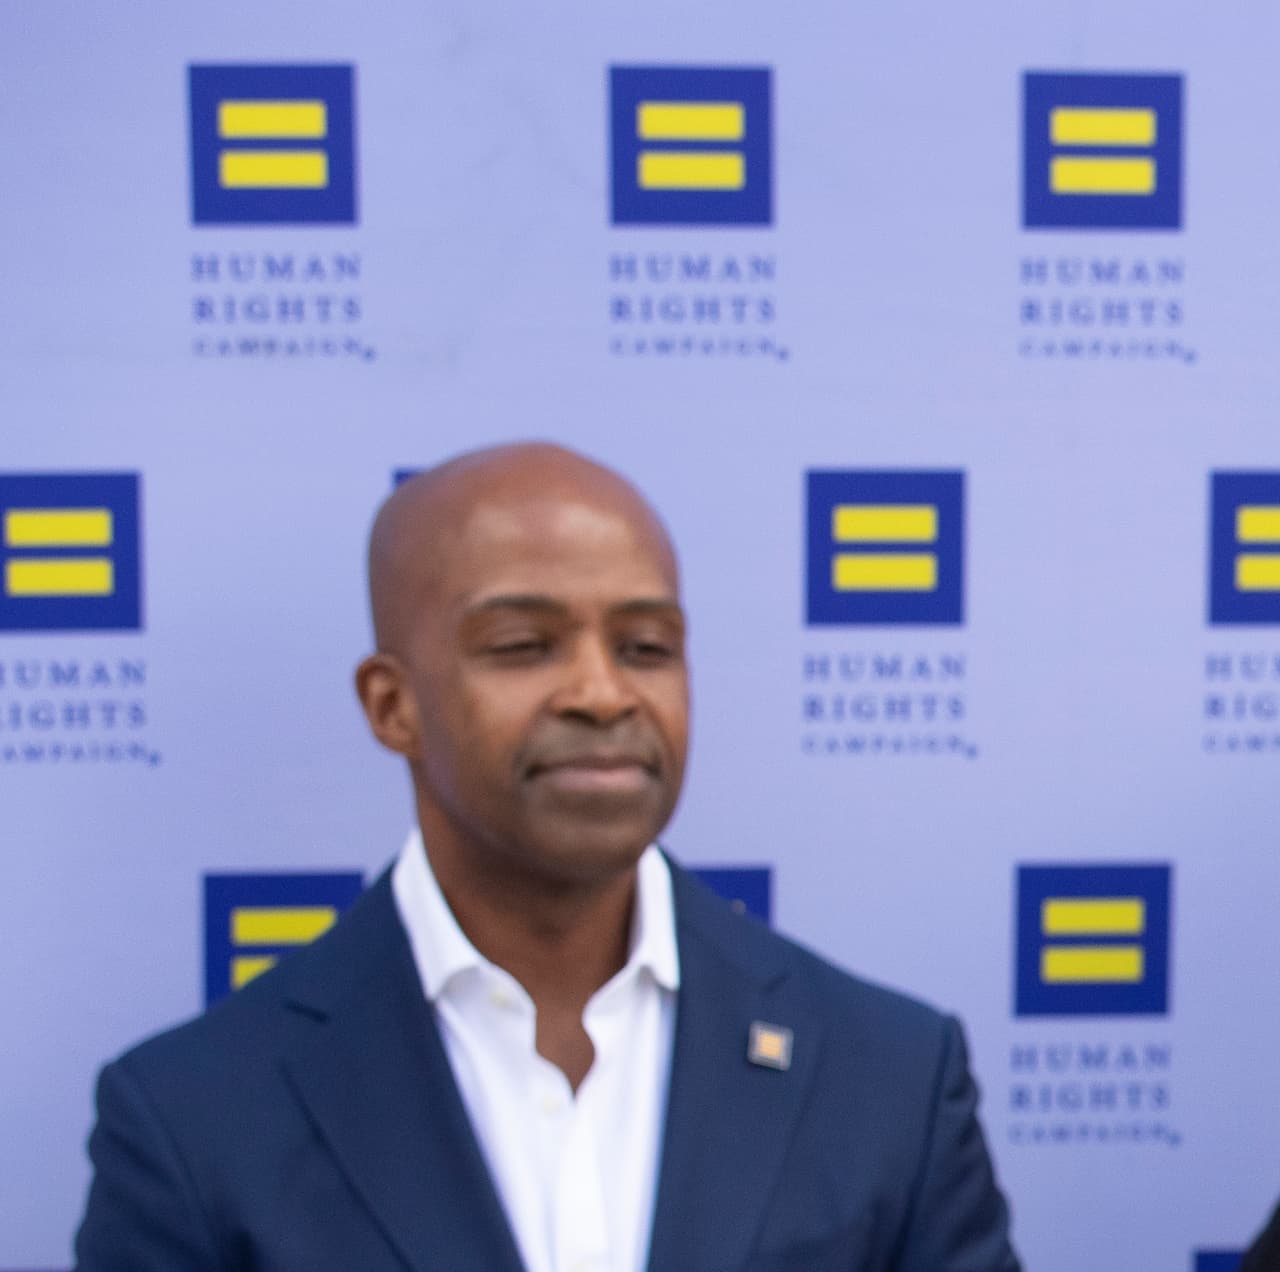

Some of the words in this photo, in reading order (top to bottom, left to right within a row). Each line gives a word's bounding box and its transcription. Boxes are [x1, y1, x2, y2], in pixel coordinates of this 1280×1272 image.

[189, 253, 362, 283] HUMAN
[607, 253, 777, 283] HUMAN
[1018, 257, 1185, 286] HUMAN
[191, 294, 363, 325] RIGHTS
[608, 294, 777, 325] RIGHTS
[1018, 296, 1184, 327] RIGHTS
[0, 659, 147, 689] UMAN
[802, 654, 967, 682] HUMAN
[0, 700, 147, 731] IGHTS
[801, 693, 966, 722] RIGHTS
[1008, 1043, 1172, 1073] HUMAN
[1008, 1082, 1170, 1113] RIGHTS
